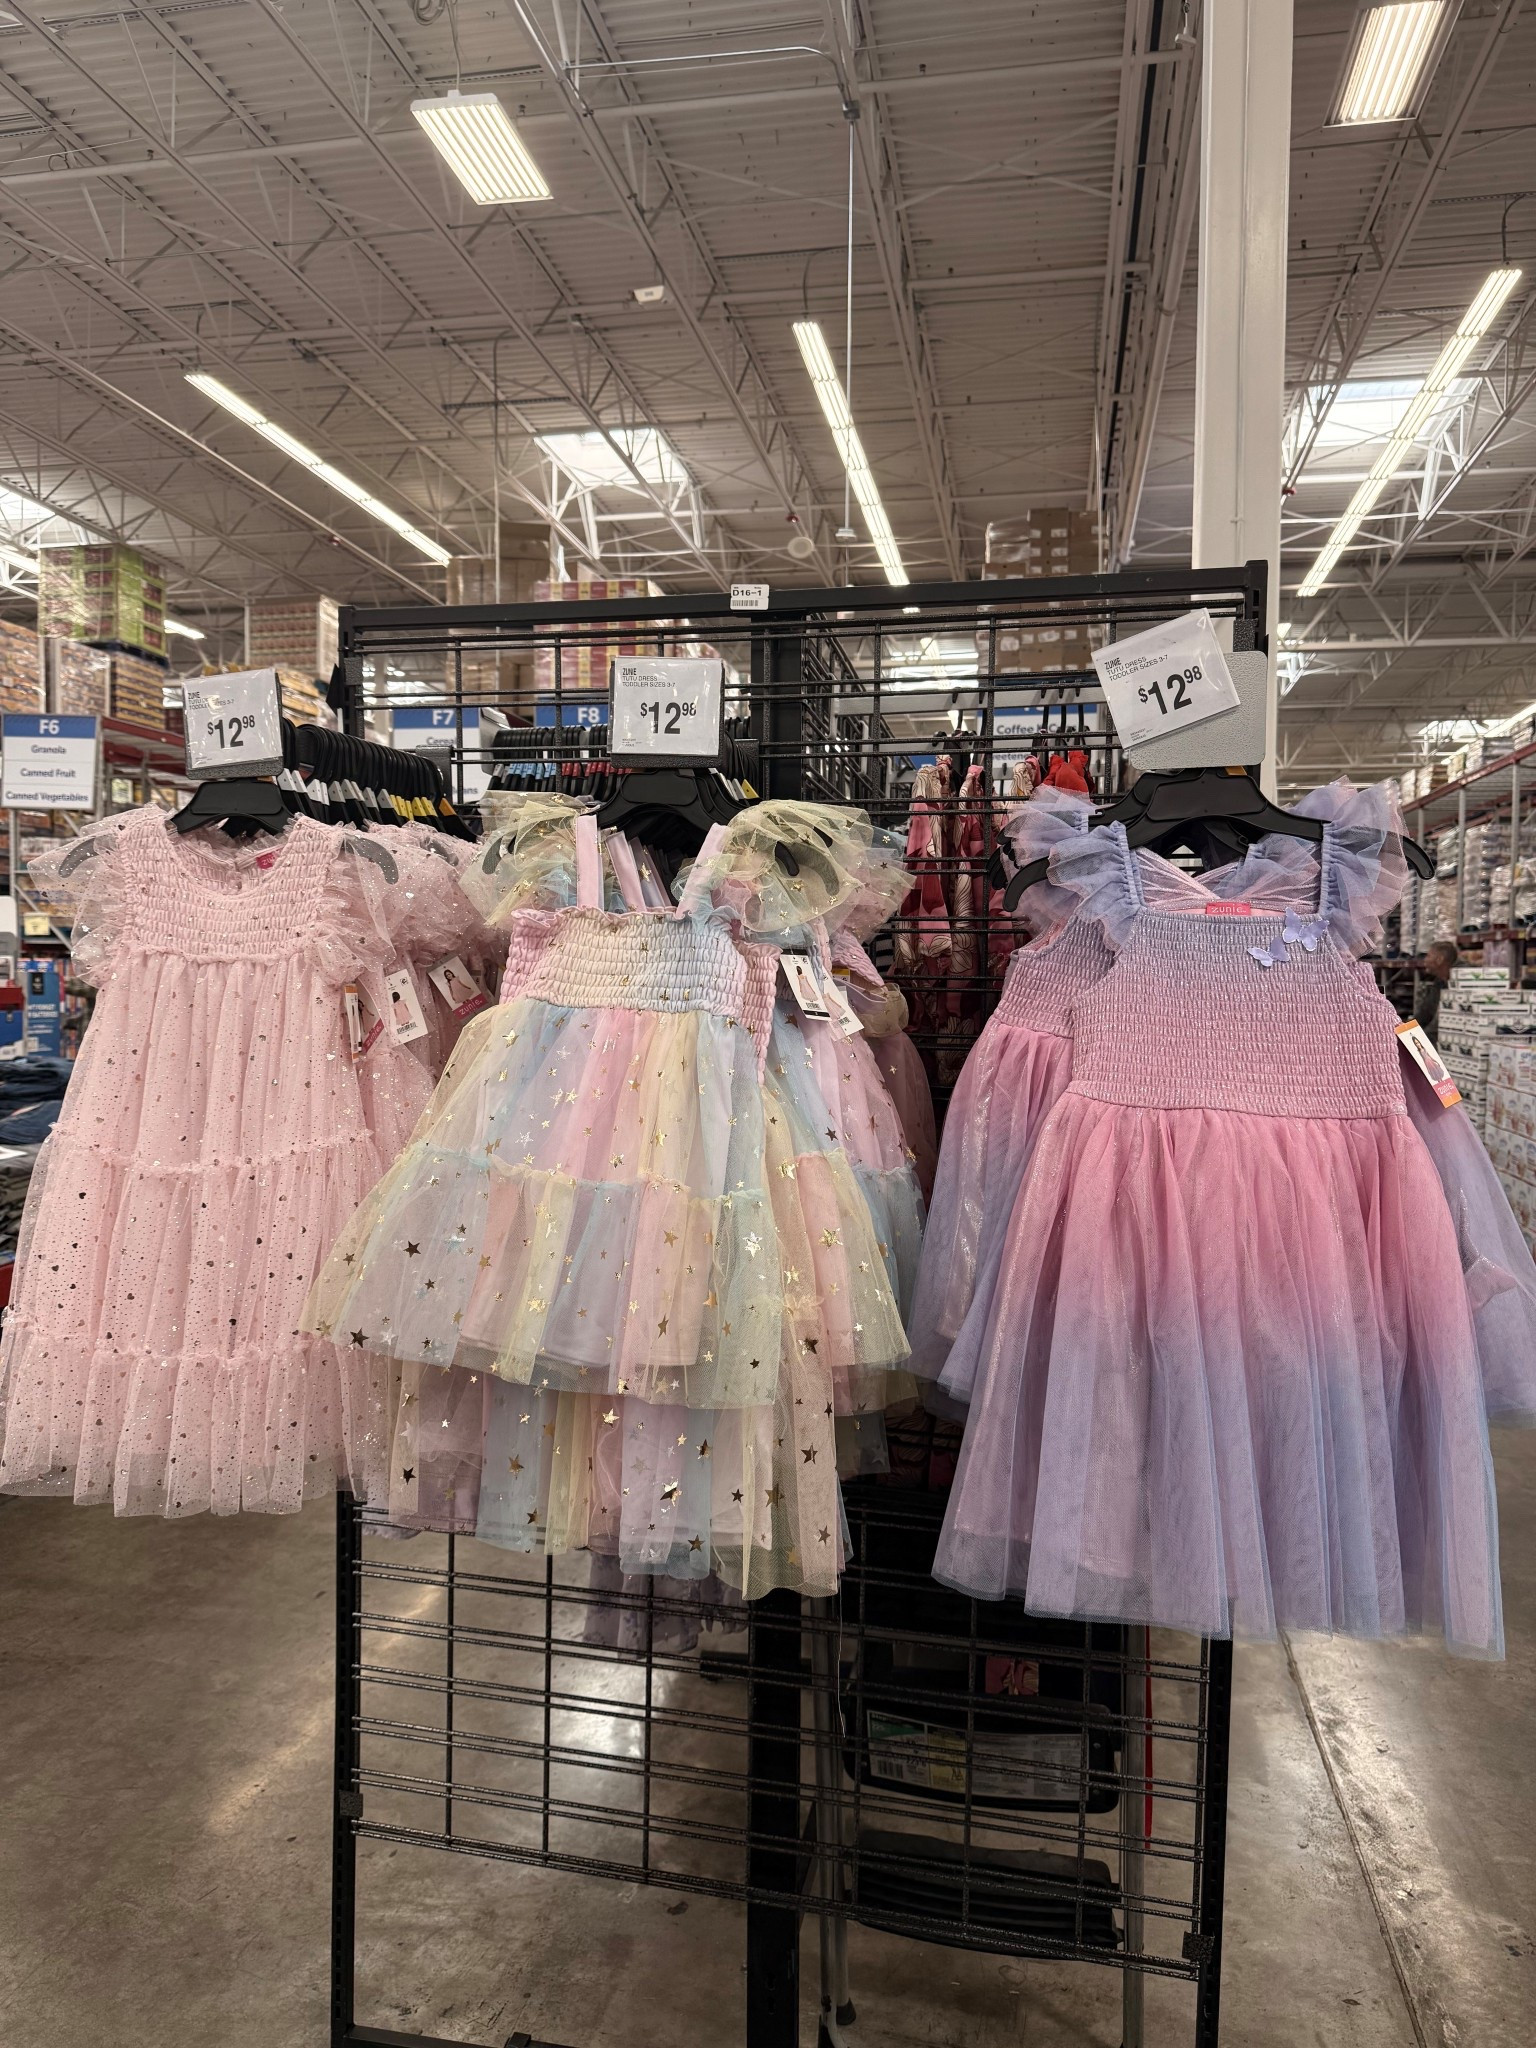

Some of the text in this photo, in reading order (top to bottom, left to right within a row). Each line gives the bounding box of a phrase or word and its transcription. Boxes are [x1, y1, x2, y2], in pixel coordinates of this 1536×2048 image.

[1107, 656, 1147, 675] TUTU DRESS
[1109, 654, 1168, 681] TODDLER SIZES 3-7
[432, 709, 455, 726] F7
[577, 707, 600, 724] F8
[39, 719, 60, 735] F6
[996, 724, 1034, 735] Coffee
[426, 736, 457, 746] Cerea
[31, 744, 67, 754] Granola
[20, 767, 77, 778] Canned Fruit
[6, 790, 89, 803] Canned Vegetables
